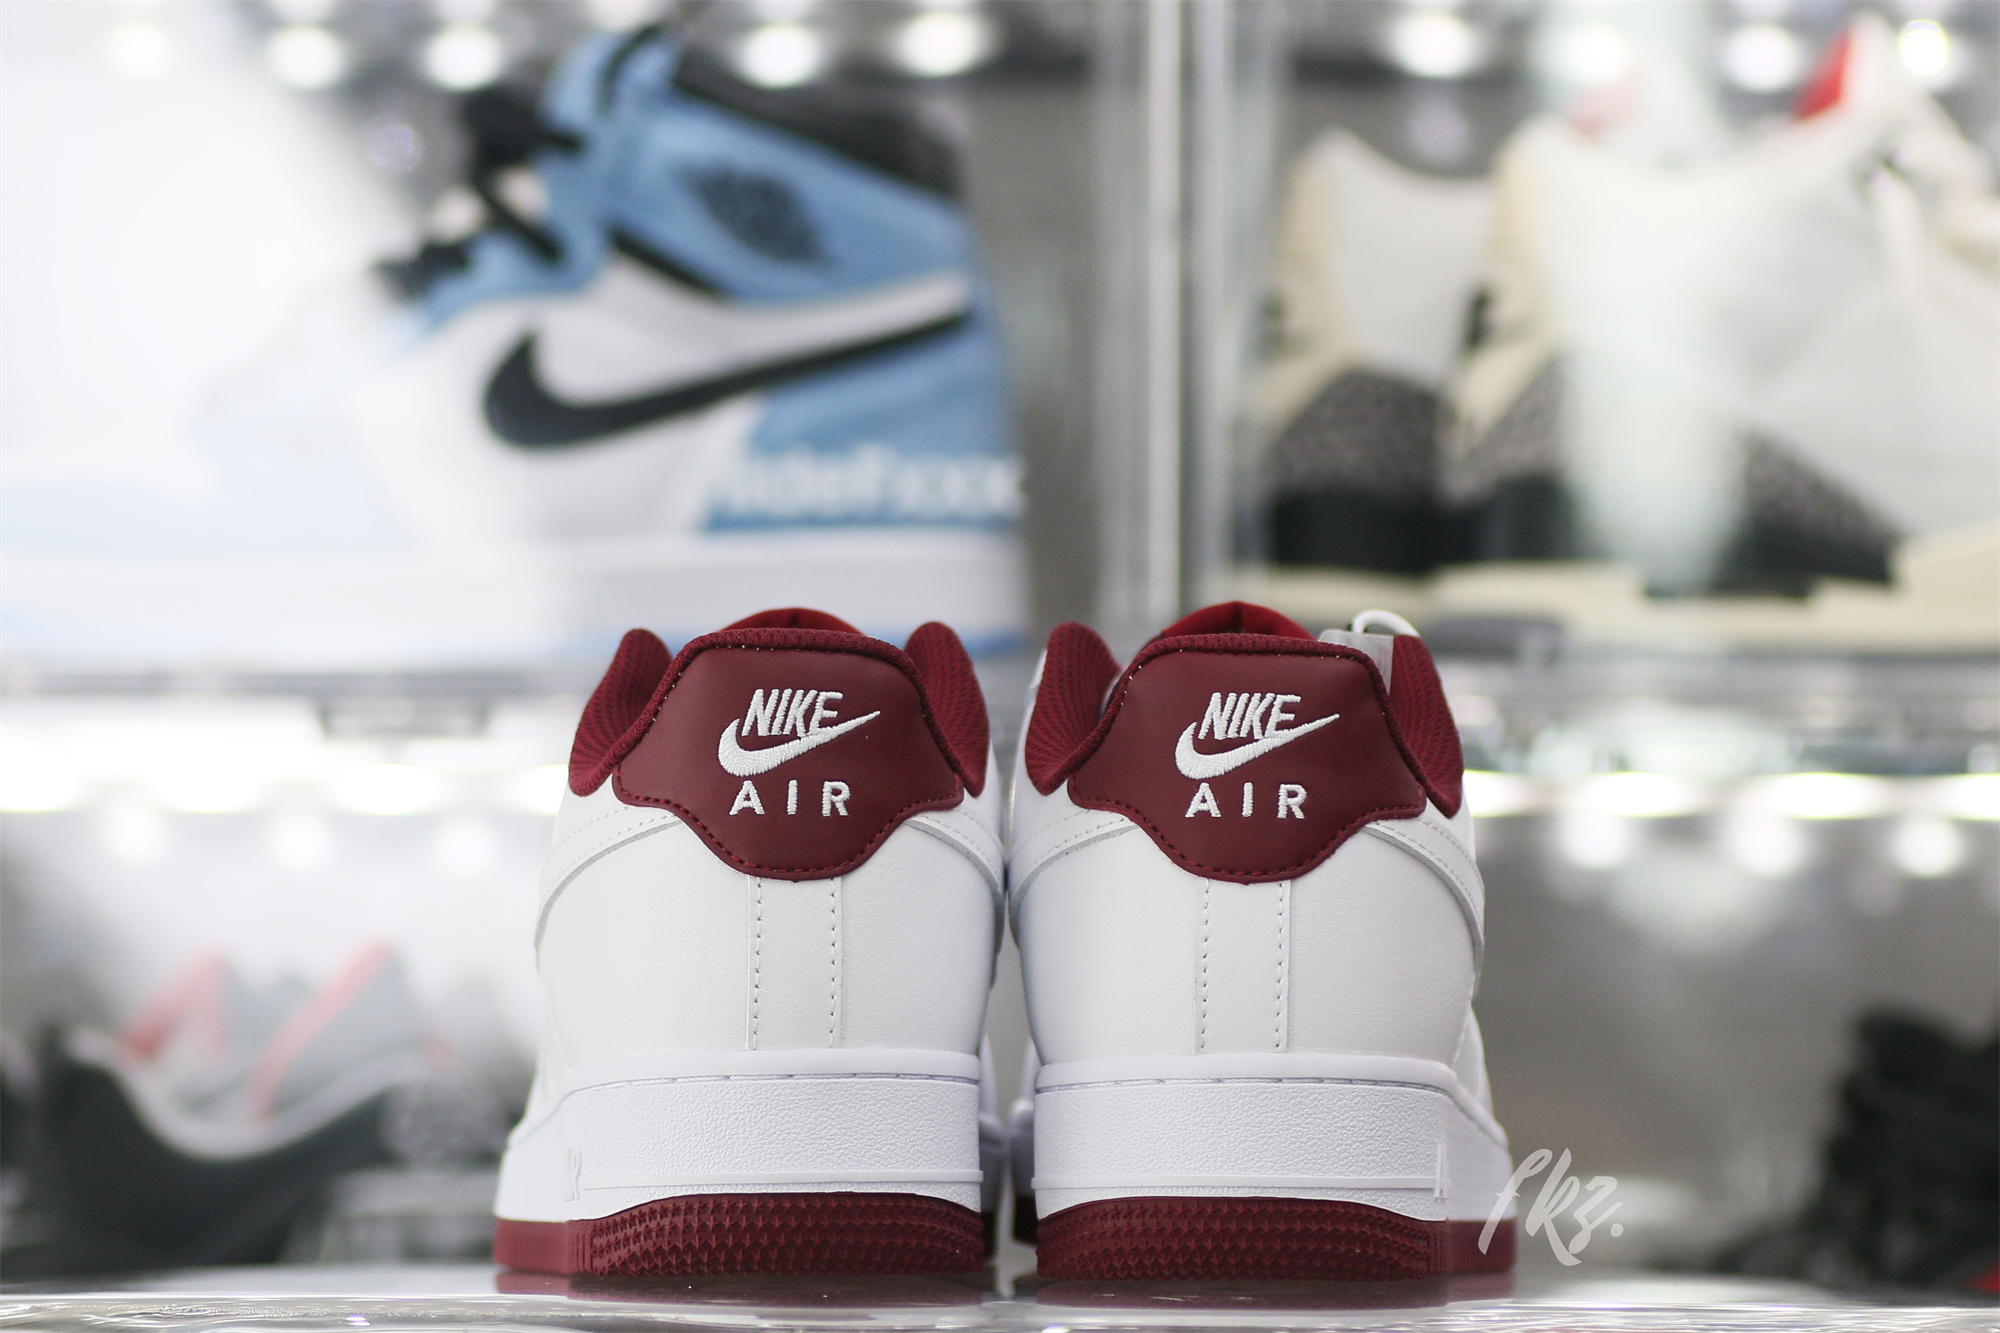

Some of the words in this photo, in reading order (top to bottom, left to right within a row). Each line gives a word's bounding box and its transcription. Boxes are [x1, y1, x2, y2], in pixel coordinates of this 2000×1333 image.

[741, 688, 843, 737] NIKE
[1198, 691, 1301, 740] NIKE
[729, 779, 850, 816] AIR
[1185, 782, 1307, 819] AIR
